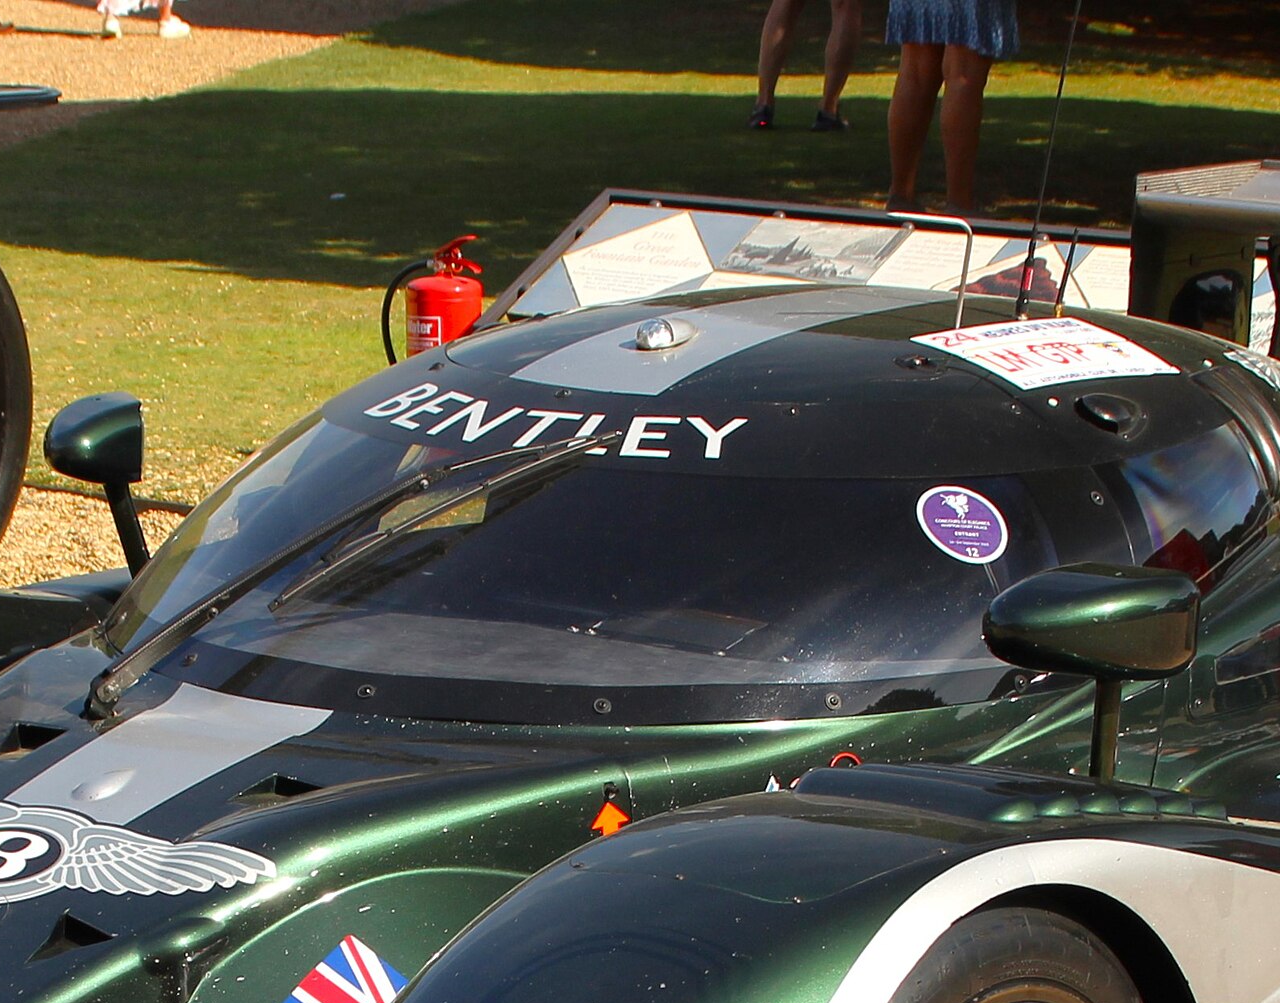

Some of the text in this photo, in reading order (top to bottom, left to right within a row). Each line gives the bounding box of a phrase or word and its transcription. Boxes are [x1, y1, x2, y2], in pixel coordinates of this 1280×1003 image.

[931, 332, 979, 348] 24
[363, 382, 749, 460] BENTLEY
[965, 547, 980, 558] 12
